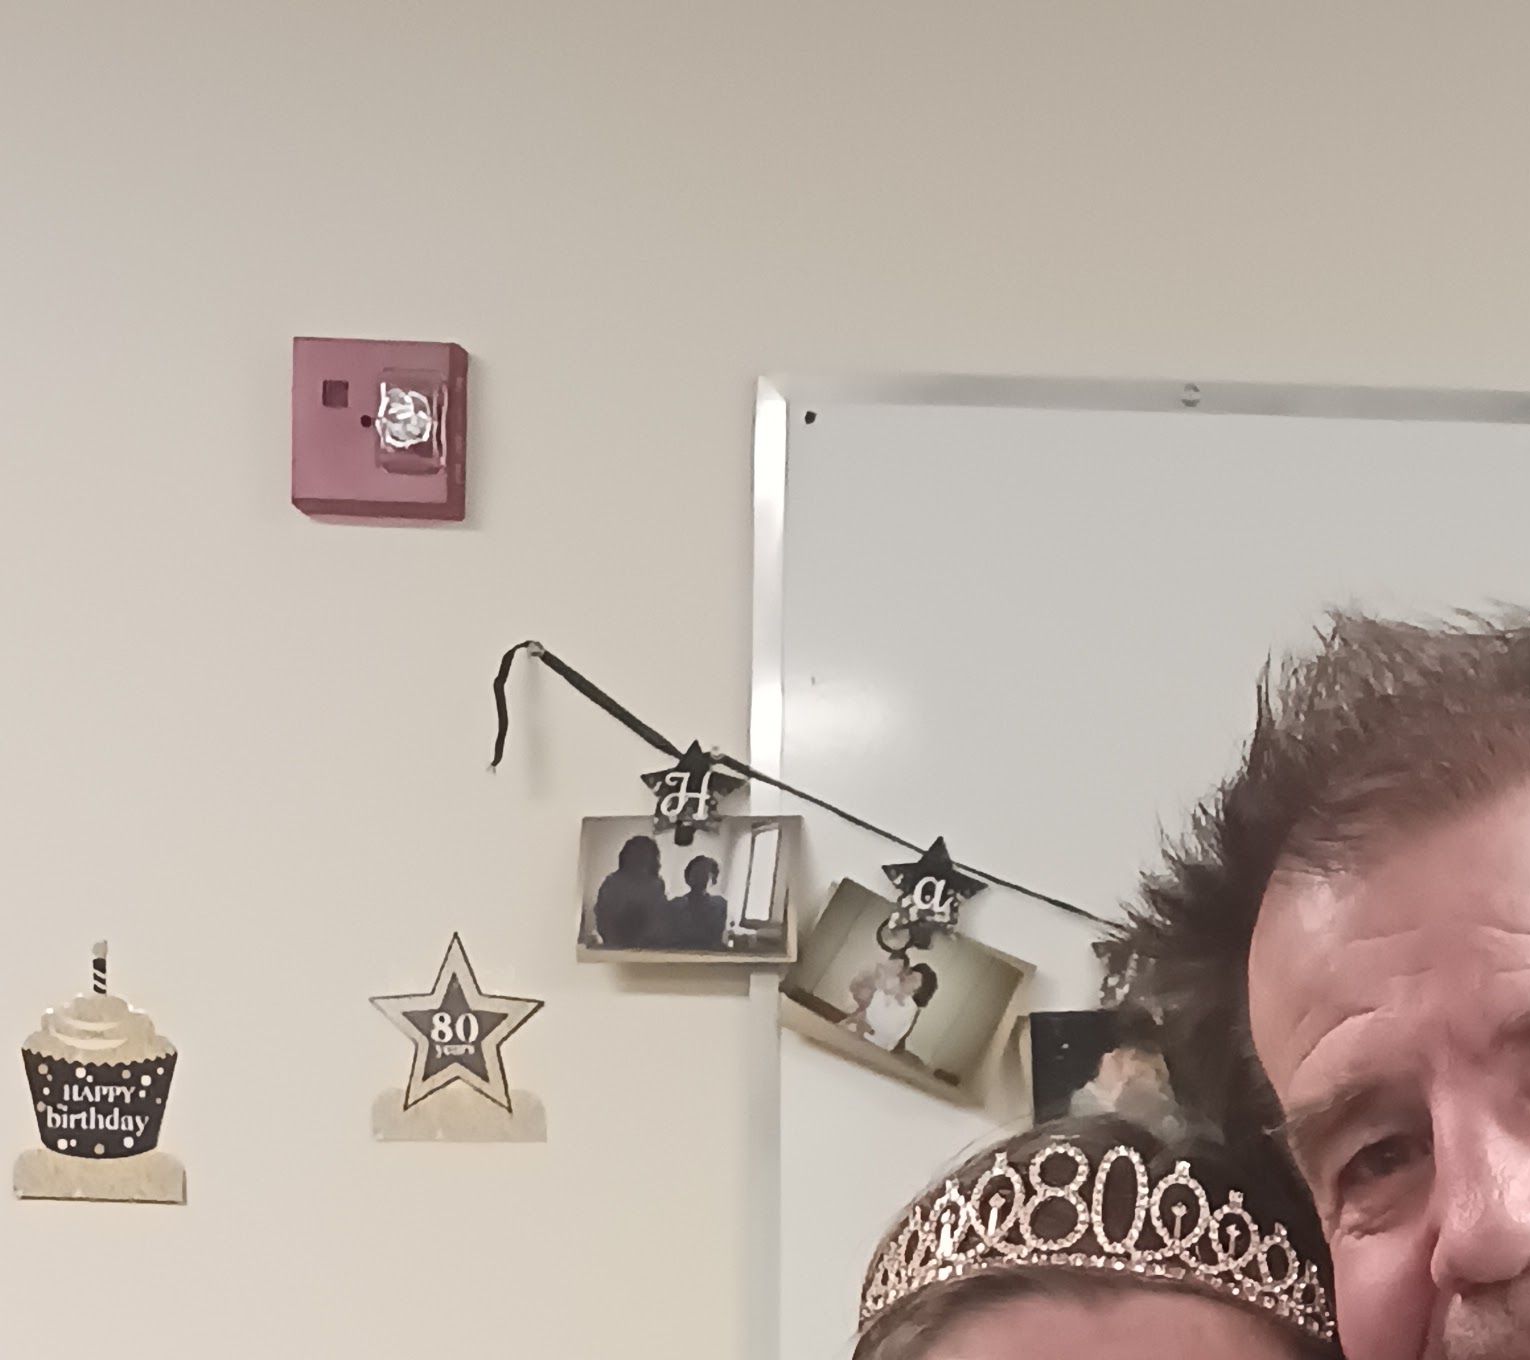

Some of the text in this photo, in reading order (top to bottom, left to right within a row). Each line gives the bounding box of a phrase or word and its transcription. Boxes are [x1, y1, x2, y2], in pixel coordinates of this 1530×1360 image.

[430, 1011, 479, 1044] 80
[63, 1083, 136, 1104] HAPPY
[46, 1105, 150, 1137] birthday
[1020, 1142, 1149, 1255] 80
